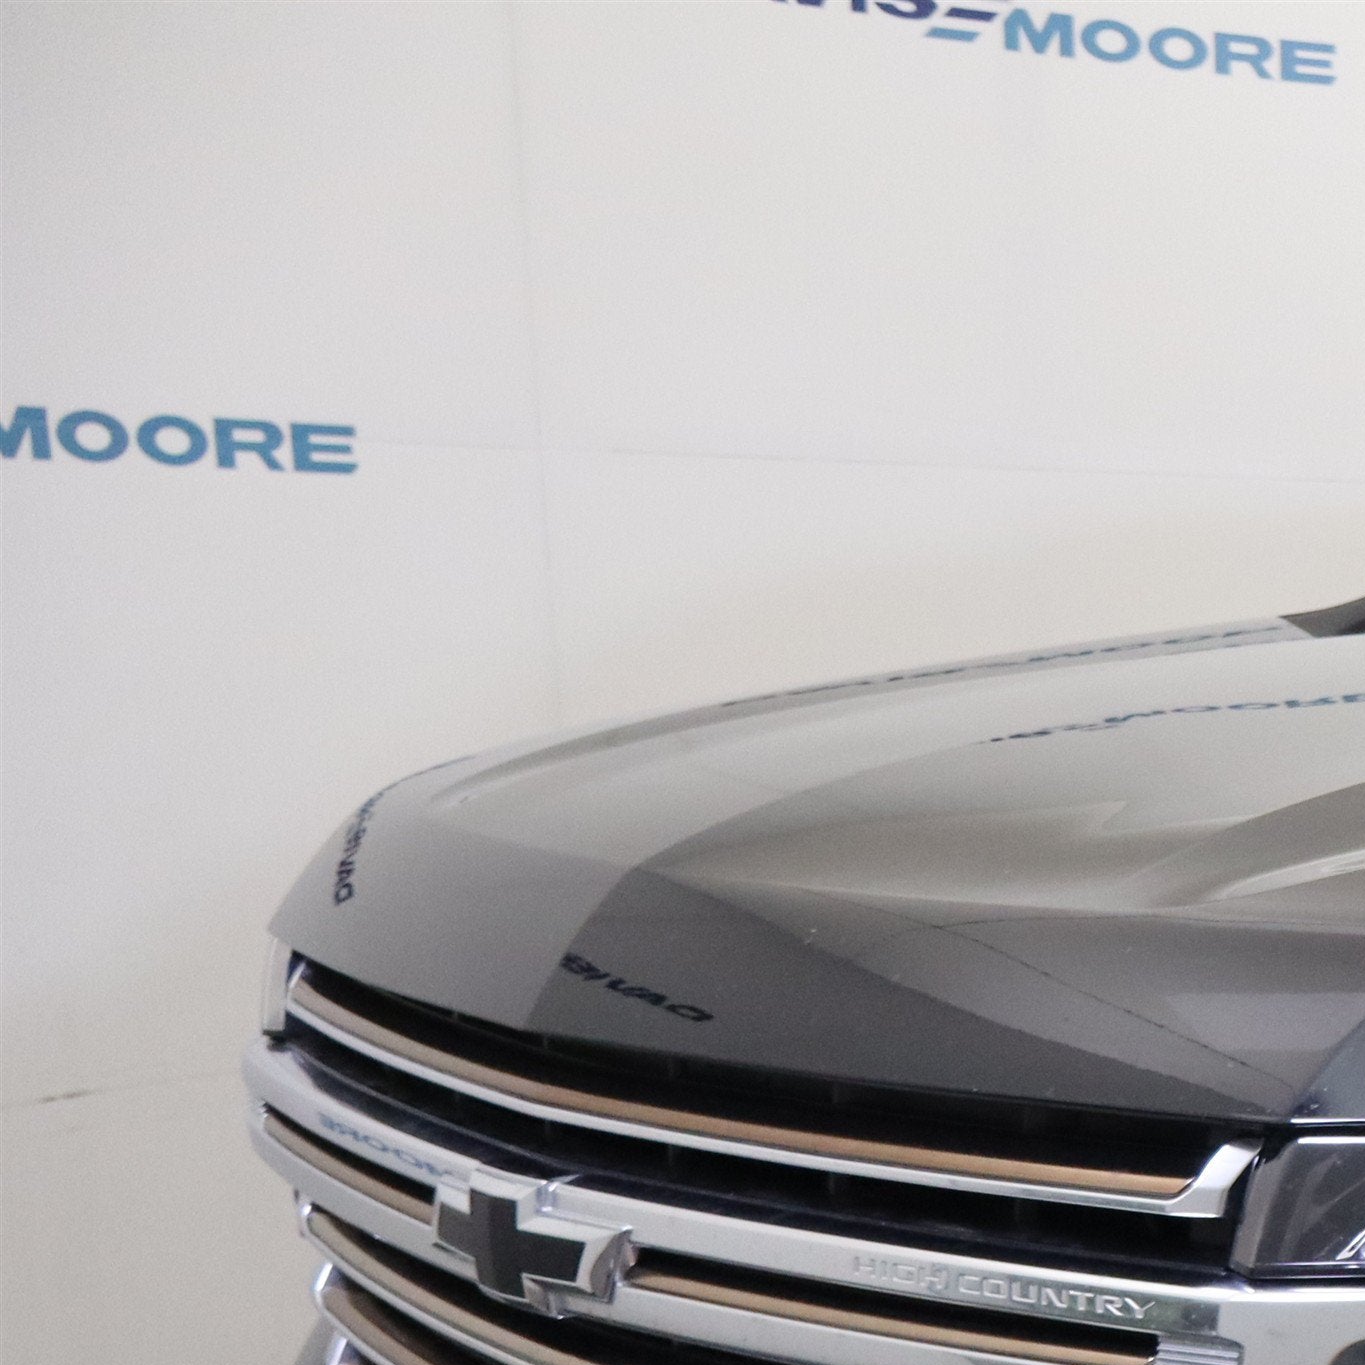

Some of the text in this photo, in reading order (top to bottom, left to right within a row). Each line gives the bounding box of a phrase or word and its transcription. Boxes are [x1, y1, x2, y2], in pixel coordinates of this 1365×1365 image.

[1002, 7, 1337, 86] MOORE
[852, 1254, 1157, 1320] HIGH COUNTRY
